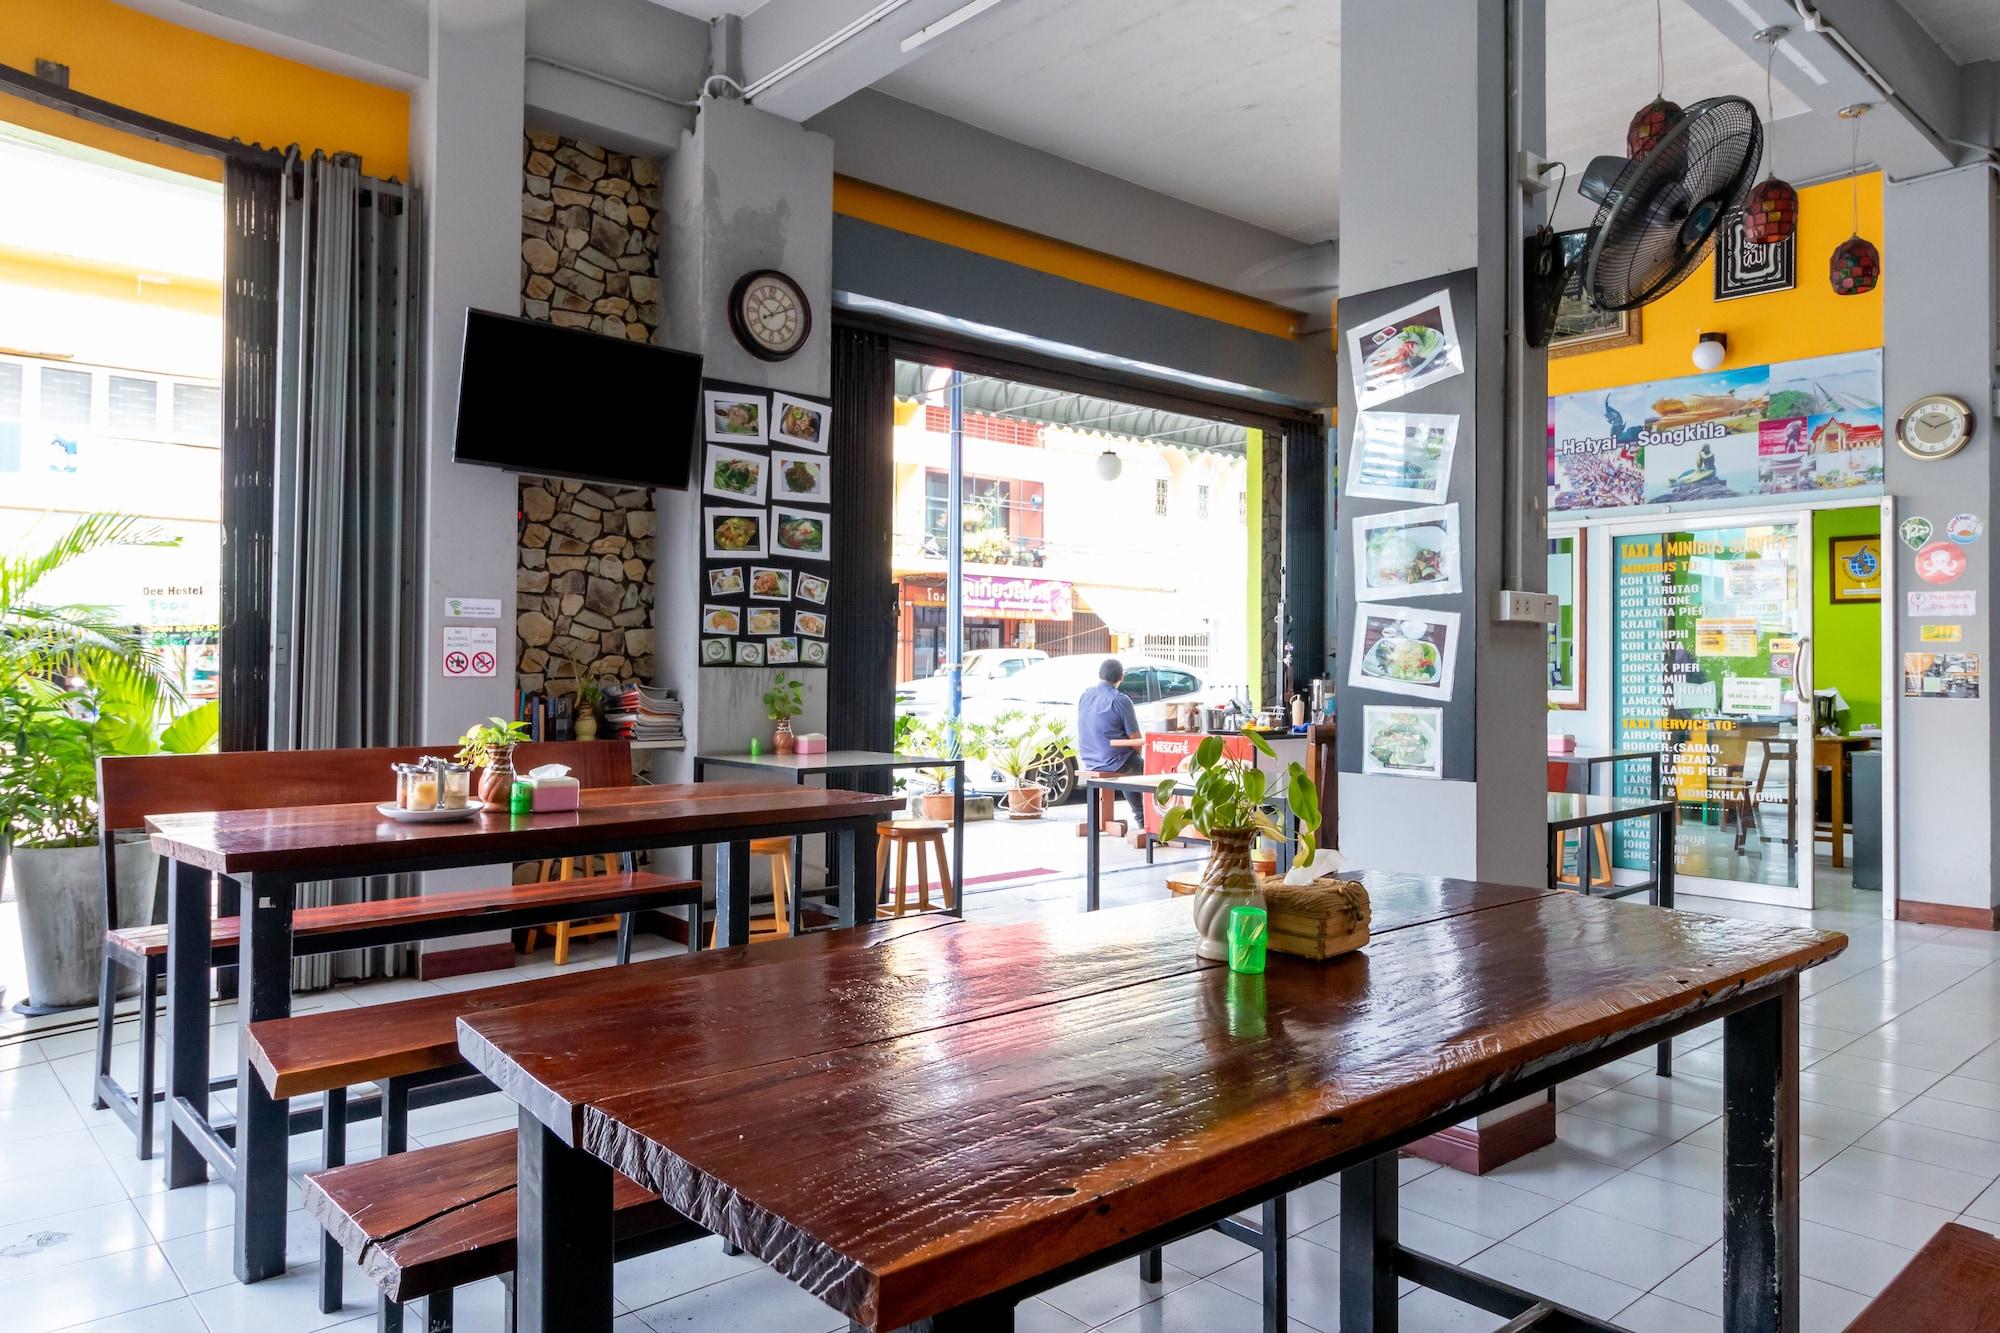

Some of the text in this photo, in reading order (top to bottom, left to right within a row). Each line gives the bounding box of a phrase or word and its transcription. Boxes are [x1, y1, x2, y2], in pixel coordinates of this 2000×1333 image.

[1562, 434, 1617, 455] Hatyai
[1637, 421, 1728, 448] Songkhla
[1621, 543, 1649, 559] TAXI
[1653, 543, 1663, 558] &
[1666, 541, 1725, 557] MINIBUS
[1621, 562, 1677, 574] MINIBUS
[1620, 574, 1672, 586] KOH LIPE
[143, 586, 203, 596] Dee Hostel
[1620, 584, 1699, 597] KOH TARUTAO
[1620, 595, 1692, 608] KOH BULONE
[1620, 605, 1707, 618] PAKBARA PIER
[1620, 619, 1657, 630] KRABI
[1621, 630, 1689, 640] KOH PHIPHI
[1621, 640, 1685, 651] KOH LANTA
[1621, 652, 1666, 662] PHUKET
[1621, 663, 1700, 673] DONSAK PIER
[1621, 674, 1687, 684] KOH SAMUI
[1621, 685, 1713, 695] KOH PHA NGAN
[1622, 696, 1682, 706] LANGKAWI
[1622, 707, 1669, 717] PENANG
[1622, 719, 1737, 731] TAXI SERVICE TO:
[1622, 731, 1673, 742] AIRPORT
[1672, 754, 1717, 766] BEZAR)
[1698, 766, 1728, 777] PIER
[1623, 775, 1684, 786] LANGAWI
[1623, 786, 1784, 803] HATYI & SONGKHLA TOUR
